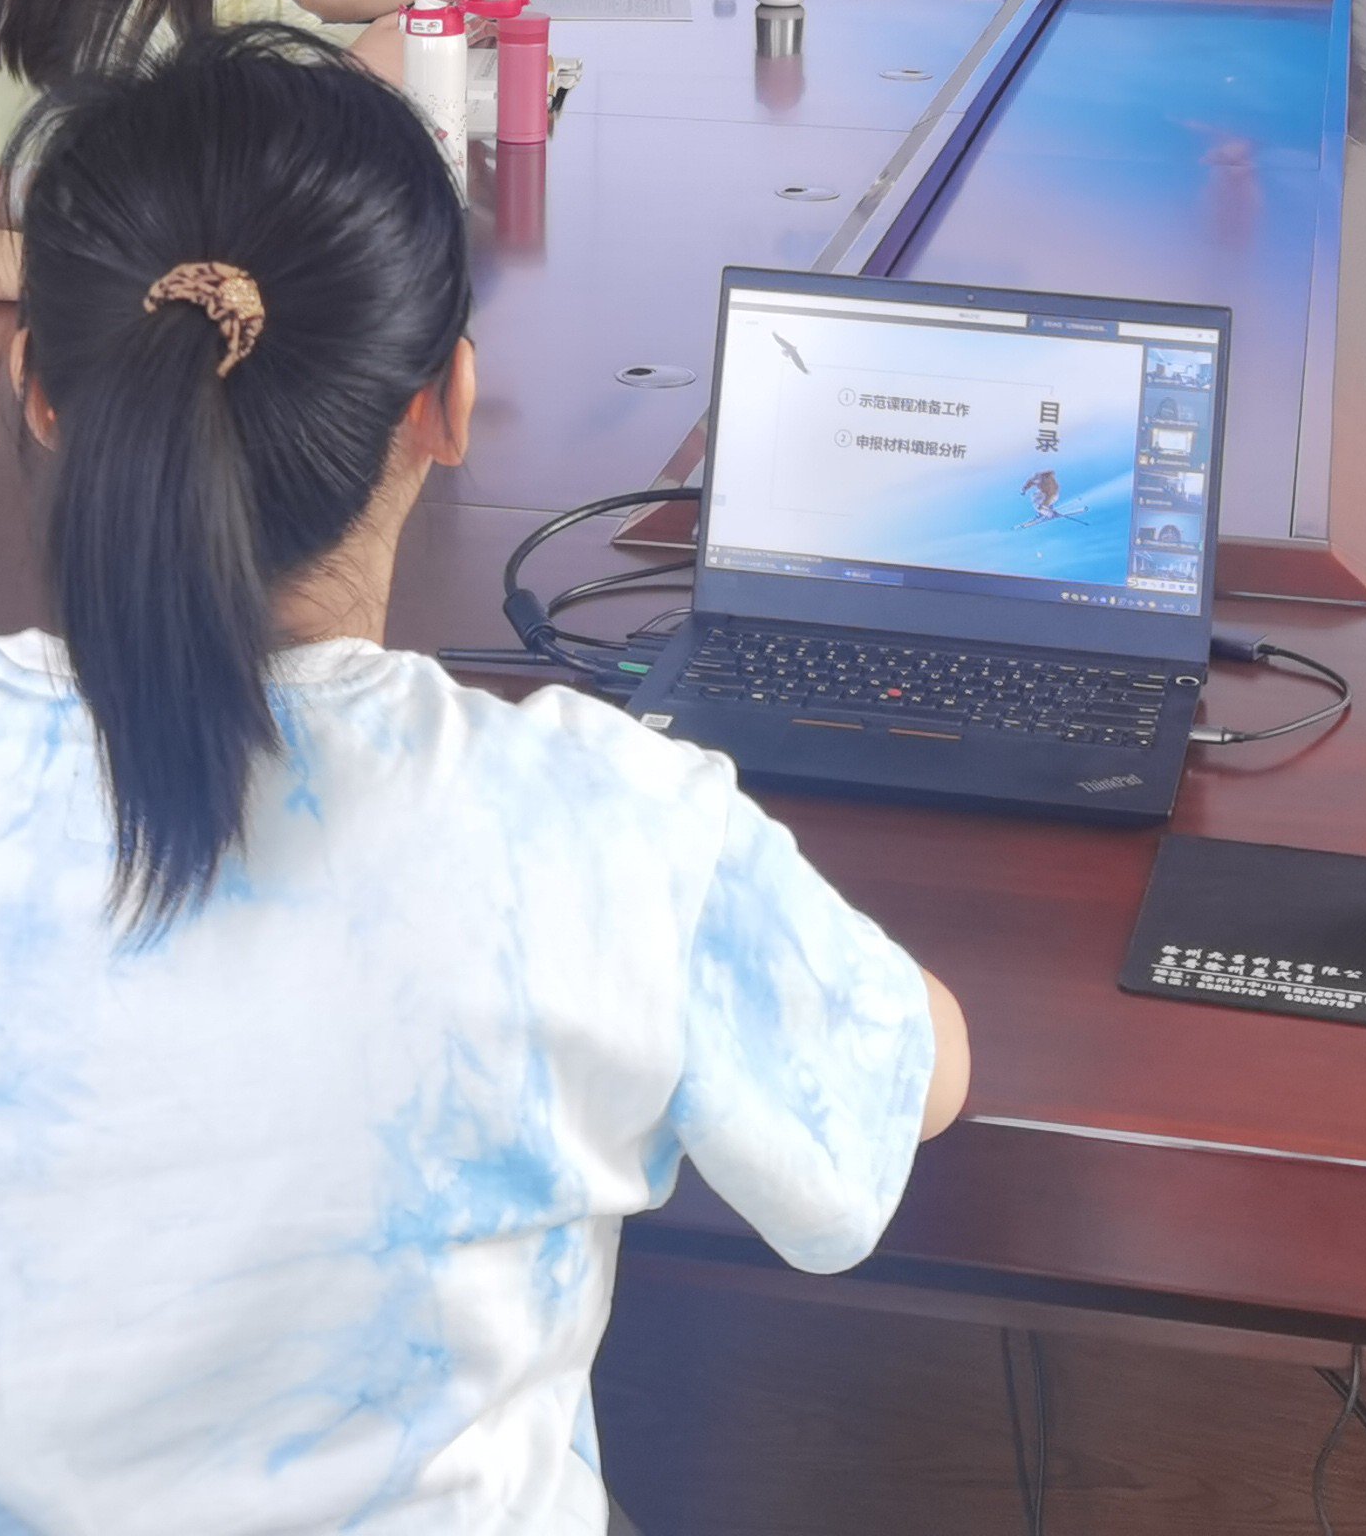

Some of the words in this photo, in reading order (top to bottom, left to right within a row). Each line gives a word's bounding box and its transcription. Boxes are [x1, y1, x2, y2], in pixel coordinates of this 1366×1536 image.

[859, 393, 971, 417] 示范课程准备工作
[856, 434, 967, 459] 申报材料填报分析
